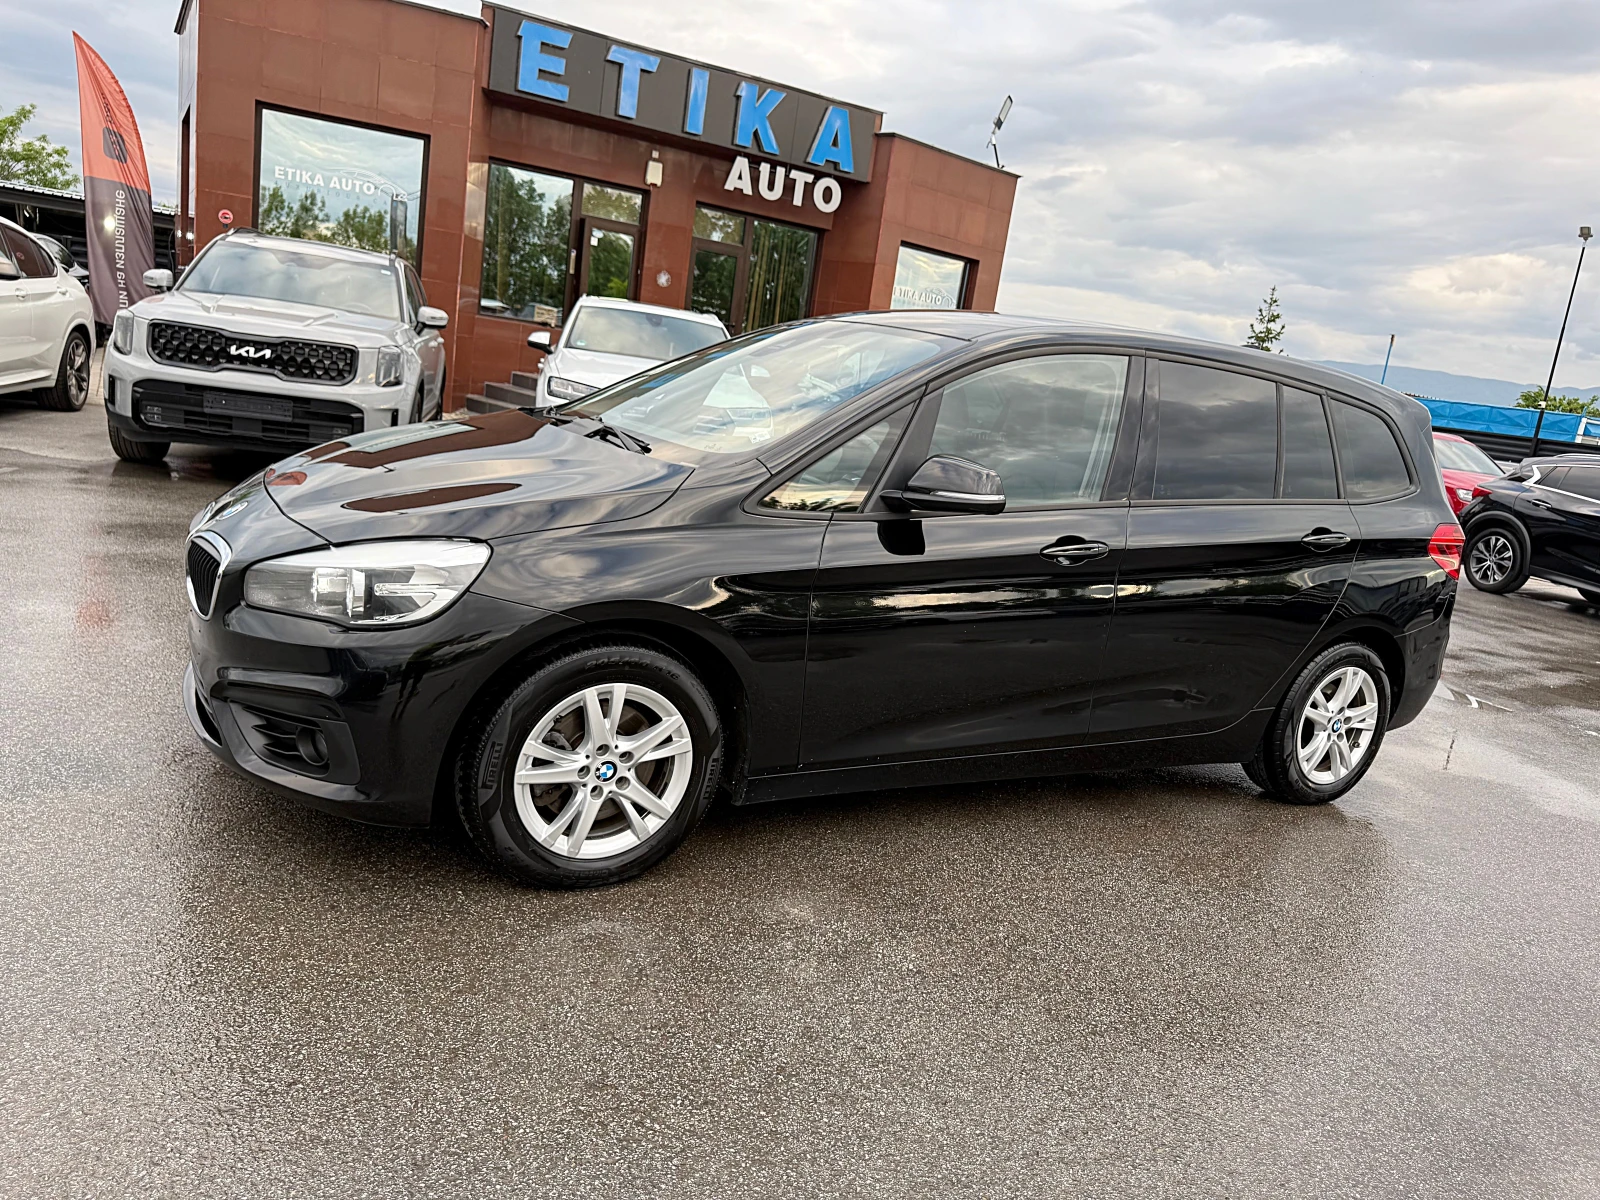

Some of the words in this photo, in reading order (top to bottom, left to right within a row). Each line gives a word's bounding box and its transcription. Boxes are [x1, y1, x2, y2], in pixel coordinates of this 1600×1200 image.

[517, 19, 855, 174] ETIKA
[274, 165, 325, 187] ETIKA
[329, 175, 375, 195] AUTO
[724, 156, 842, 213] AUTO
[919, 291, 942, 305] AUTO
[230, 344, 272, 359] KIA
[481, 741, 503, 789] PIRELLI
[702, 757, 719, 800] PIRELLI
